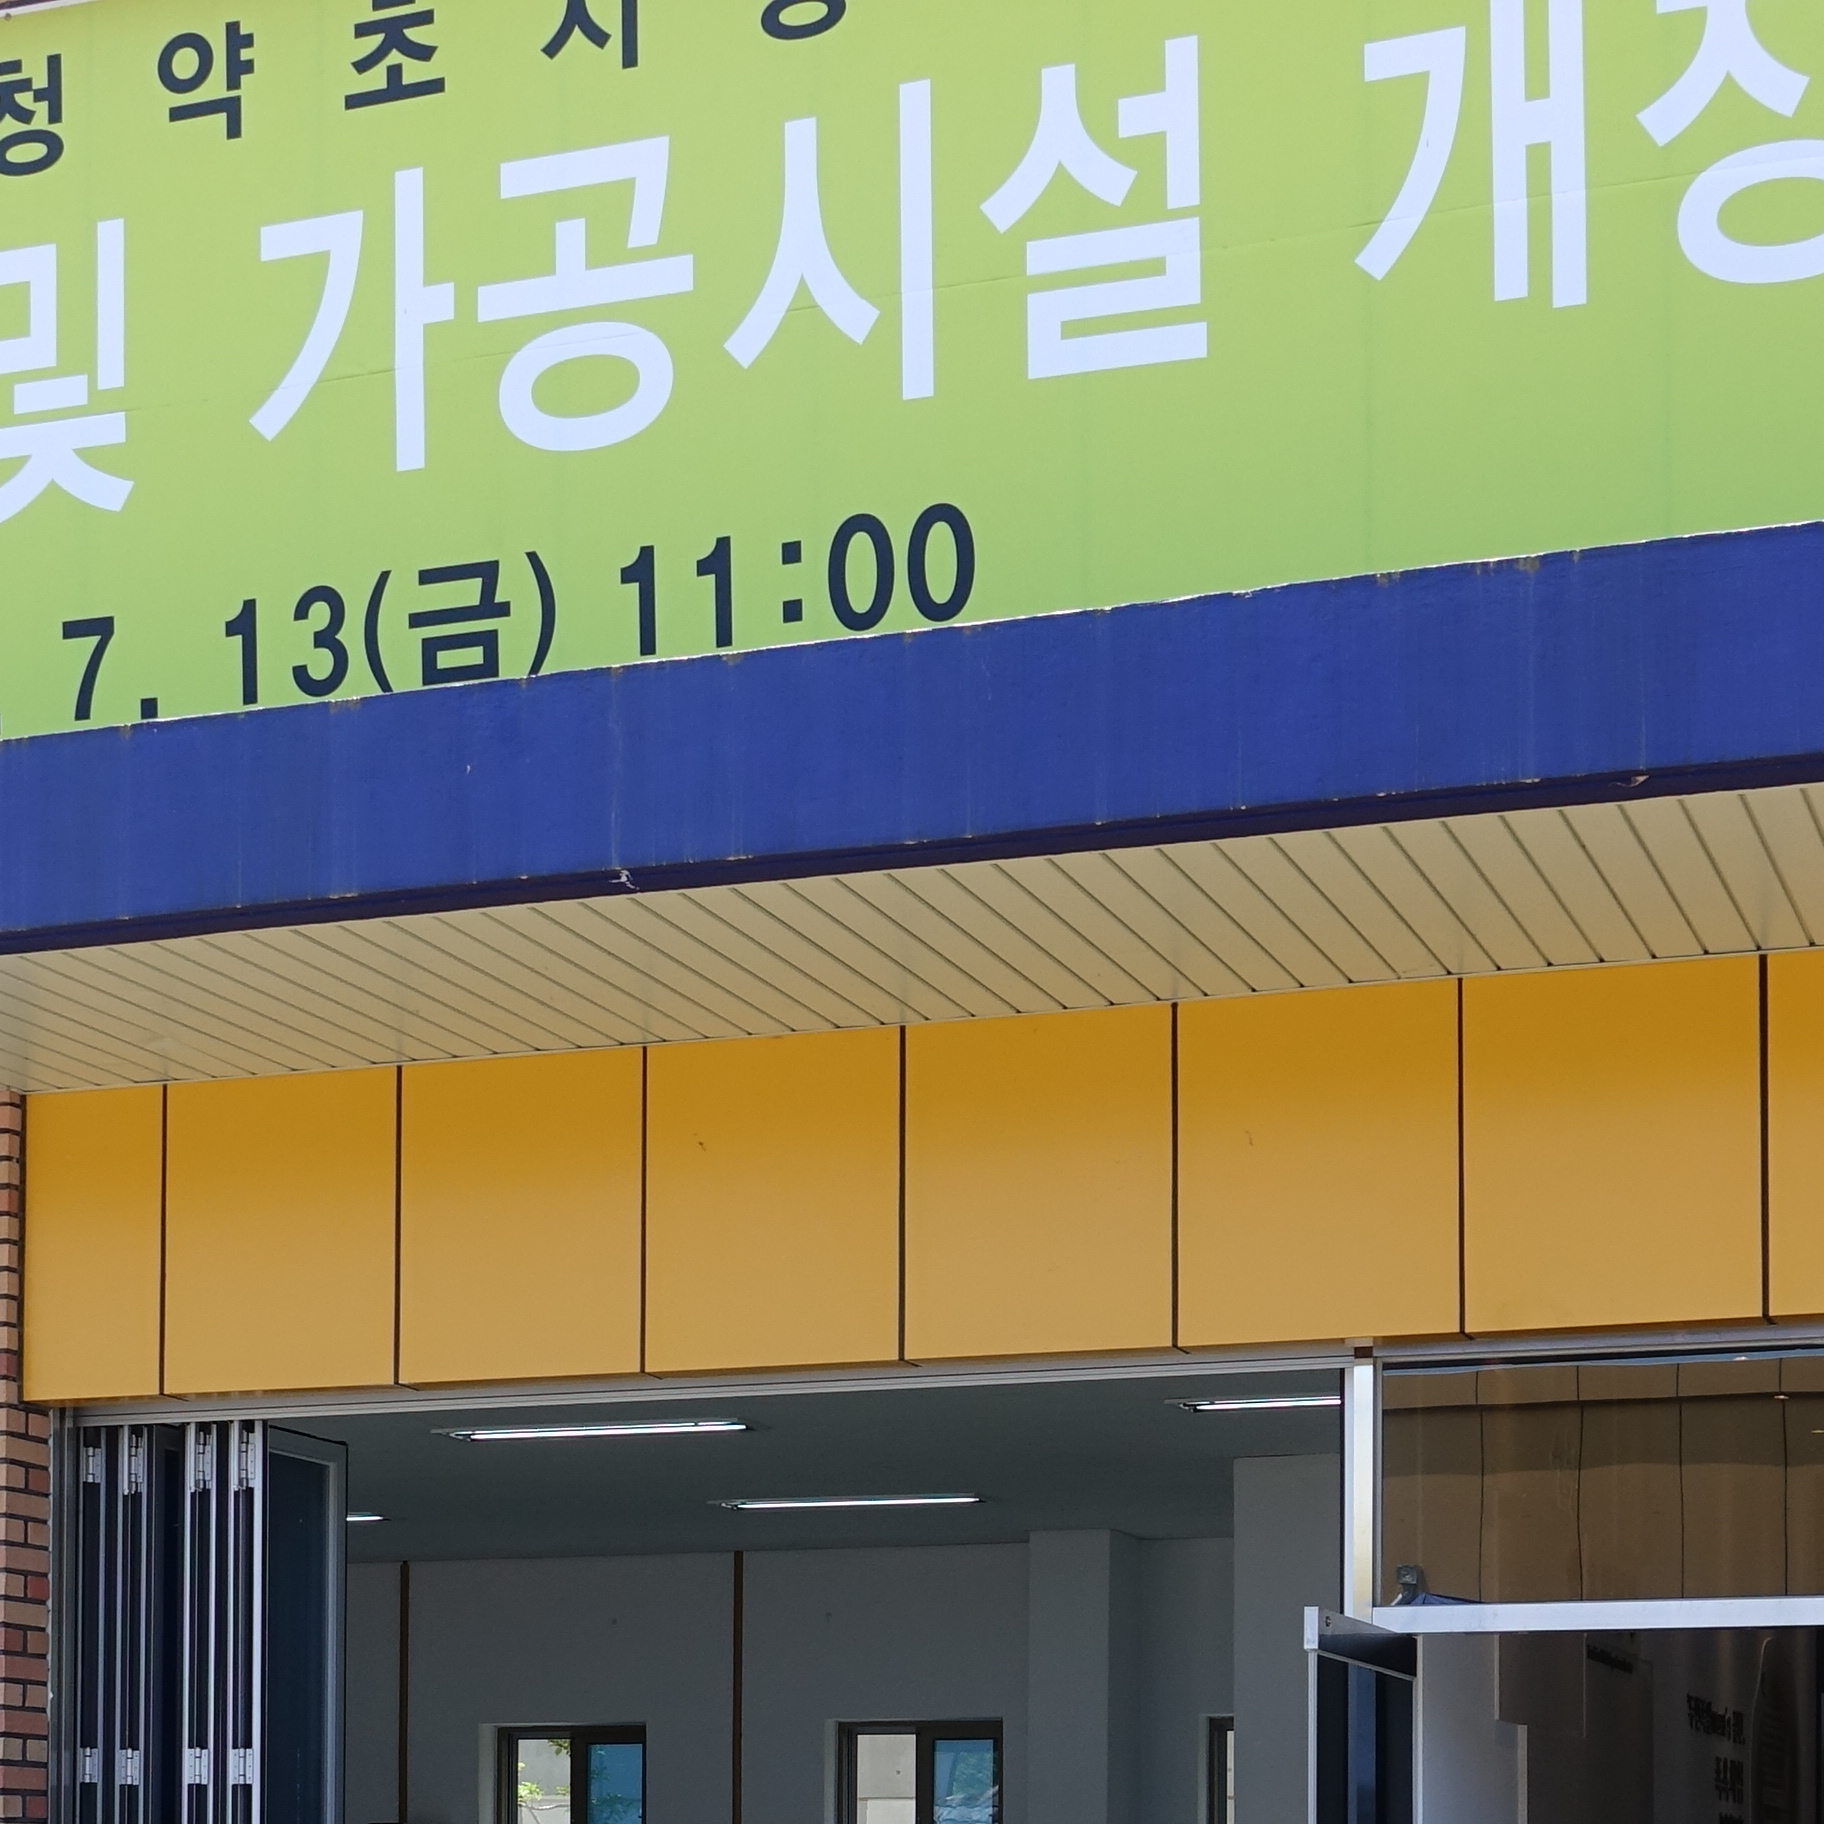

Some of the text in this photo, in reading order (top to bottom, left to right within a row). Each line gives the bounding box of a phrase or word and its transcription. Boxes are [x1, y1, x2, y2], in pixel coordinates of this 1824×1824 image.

[248, 34, 1210, 476] 가공시설
[60, 614, 161, 724] 7.
[223, 550, 560, 700] 13(금)
[619, 500, 978, 656] 11:00
